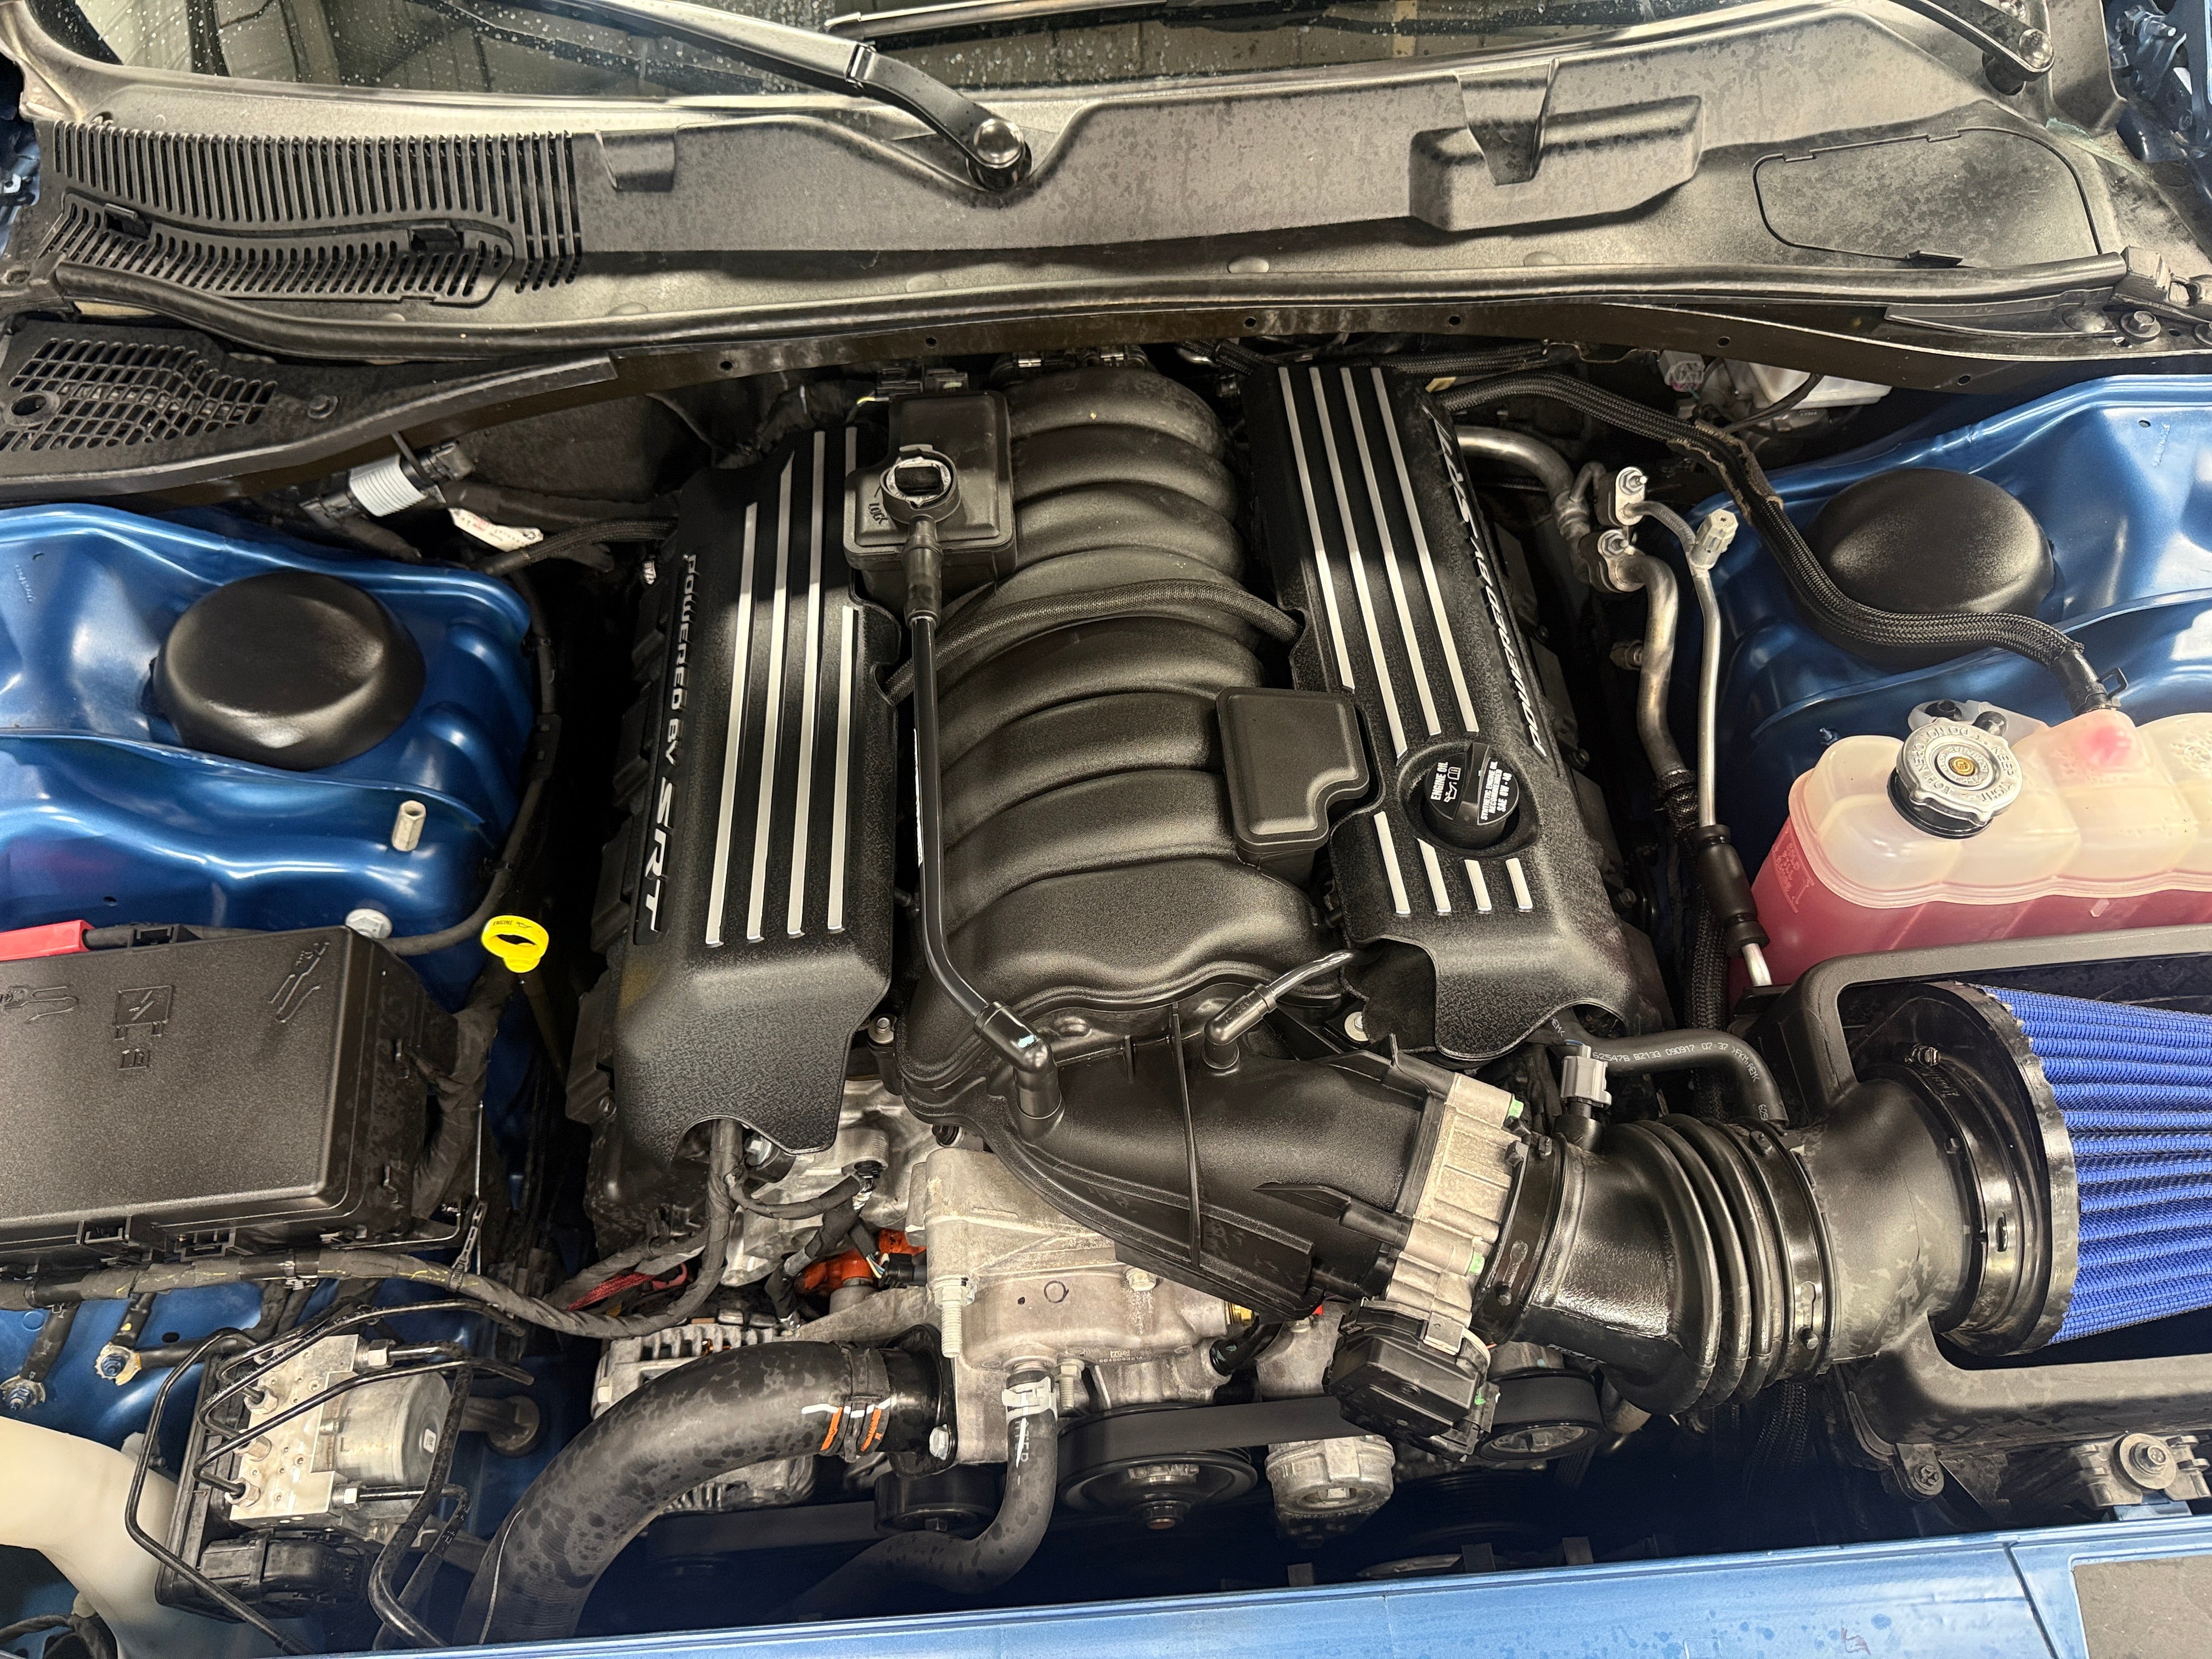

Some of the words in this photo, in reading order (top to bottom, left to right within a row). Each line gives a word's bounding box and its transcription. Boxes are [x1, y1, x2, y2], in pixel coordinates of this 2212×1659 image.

[1421, 404, 1479, 539] SRT
[868, 503, 889, 524] LOCK
[1470, 537, 1493, 586] BY
[671, 554, 697, 710] POWERED
[1485, 585, 1547, 757] POWERED
[665, 718, 679, 765] BY
[1437, 761, 1448, 772] OIL
[1486, 770, 1496, 789] ENGINE
[1489, 761, 1498, 770] OIL
[1430, 773, 1446, 800] ENGINE
[1489, 769, 1503, 814] RECOMMENDED
[1481, 789, 1491, 820] SYNTHETIC
[1497, 798, 1507, 812] SAE
[645, 777, 673, 931] SRT
[1593, 1052, 1630, 1062] 62547B
